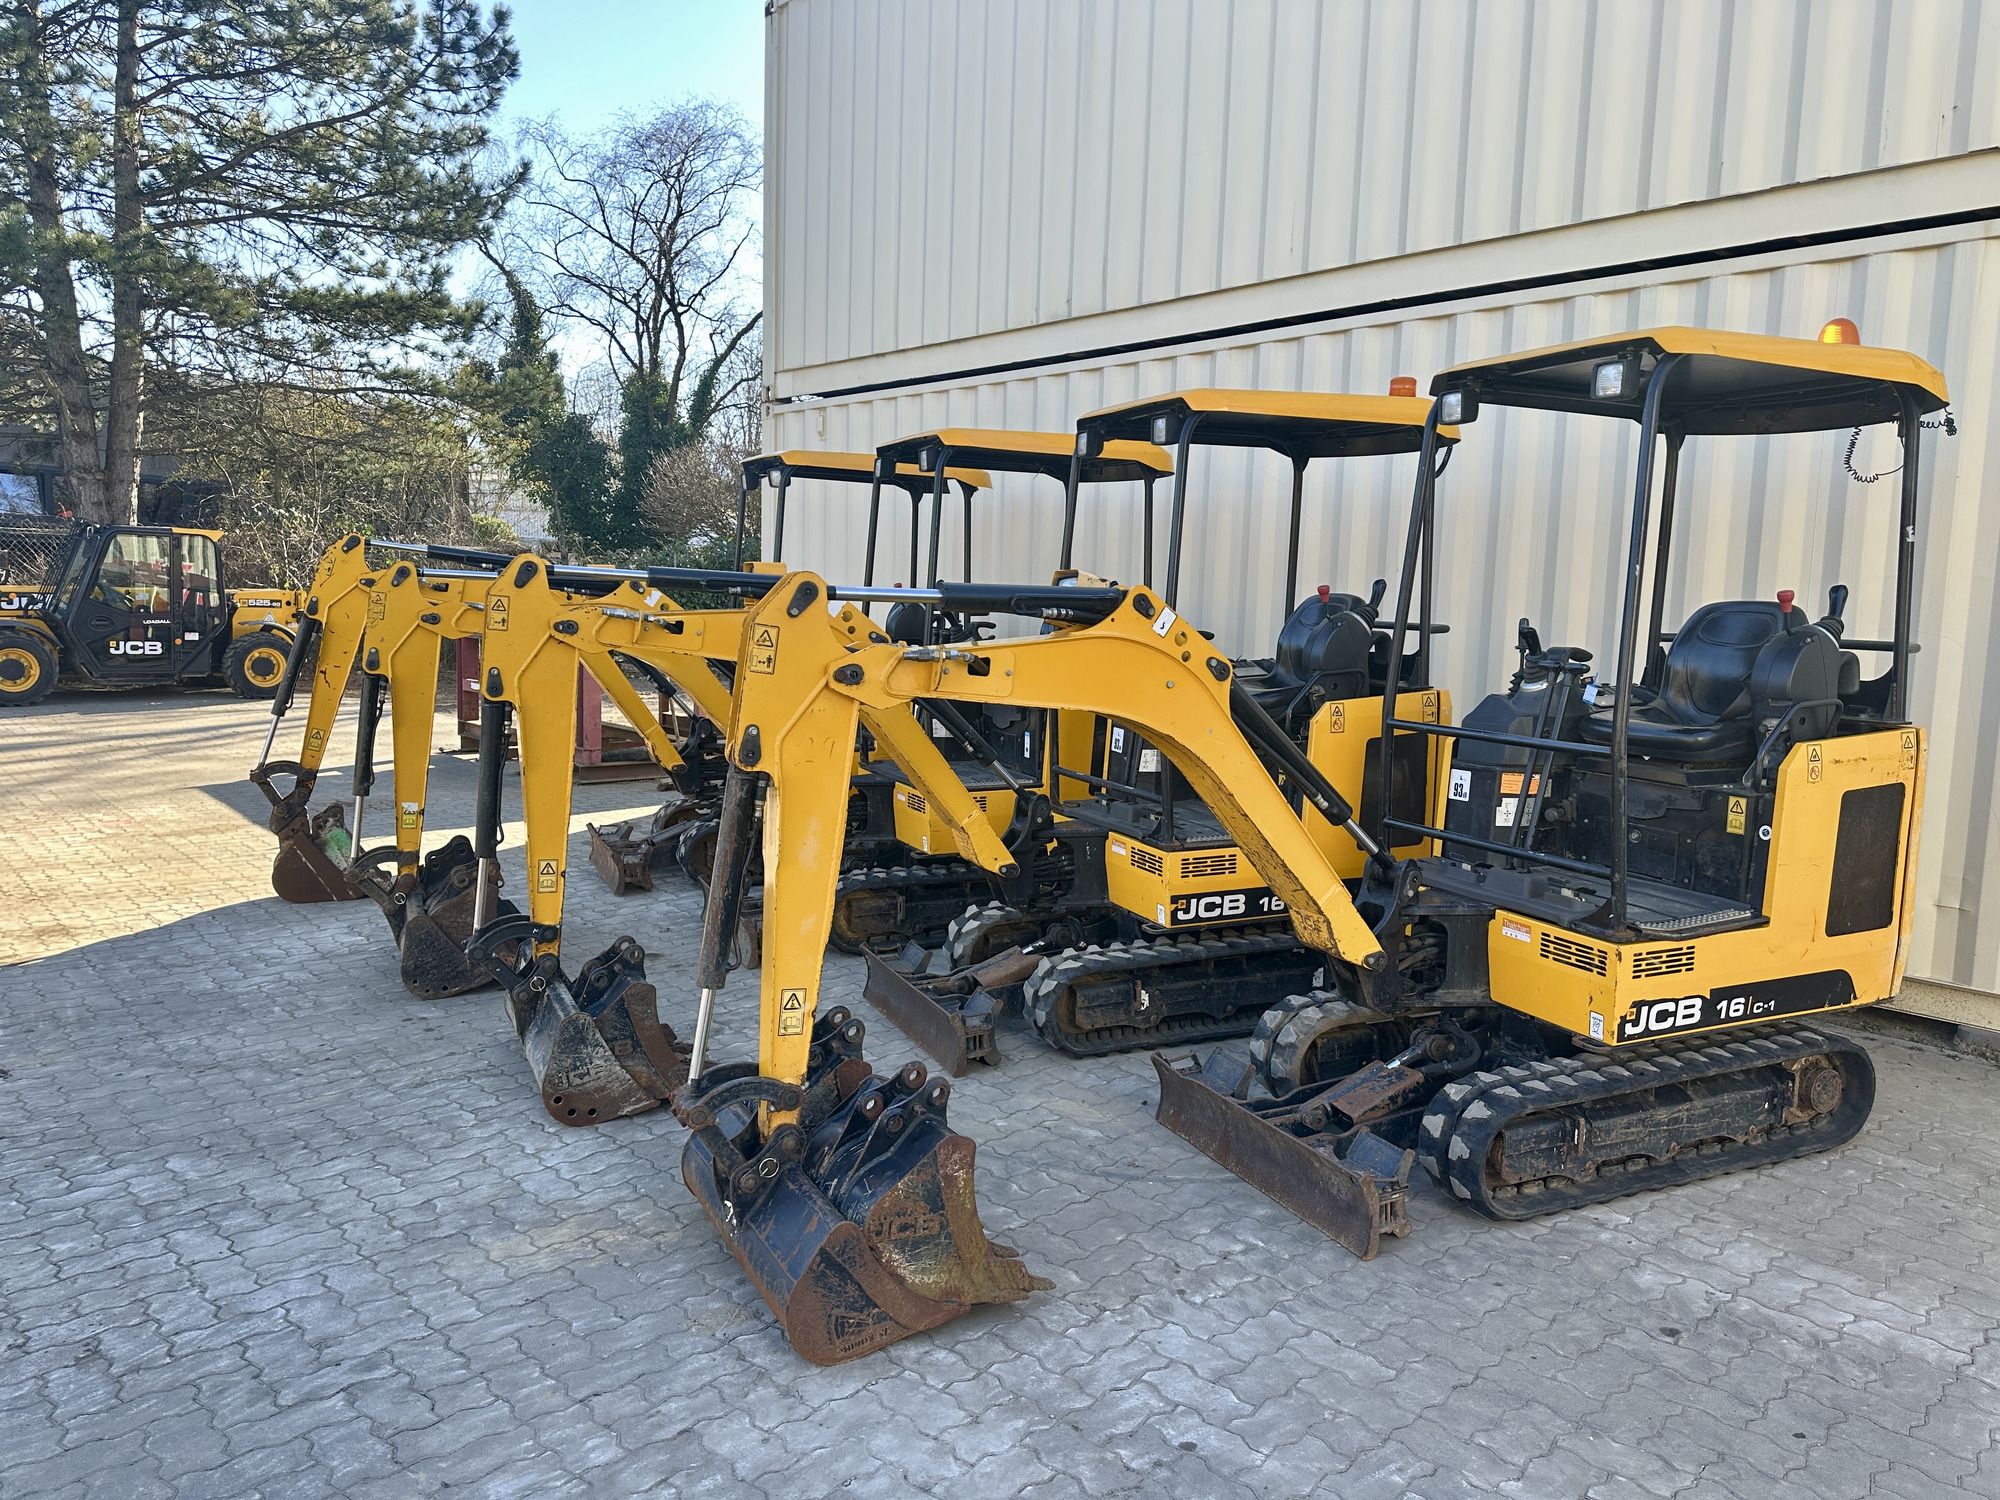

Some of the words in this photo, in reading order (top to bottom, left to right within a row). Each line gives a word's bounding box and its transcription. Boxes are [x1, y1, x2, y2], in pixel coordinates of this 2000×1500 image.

[109, 641, 162, 654] JCB
[1177, 894, 1246, 920] JCB
[1259, 896, 1285, 912] 16
[1625, 997, 1703, 1035] JCB
